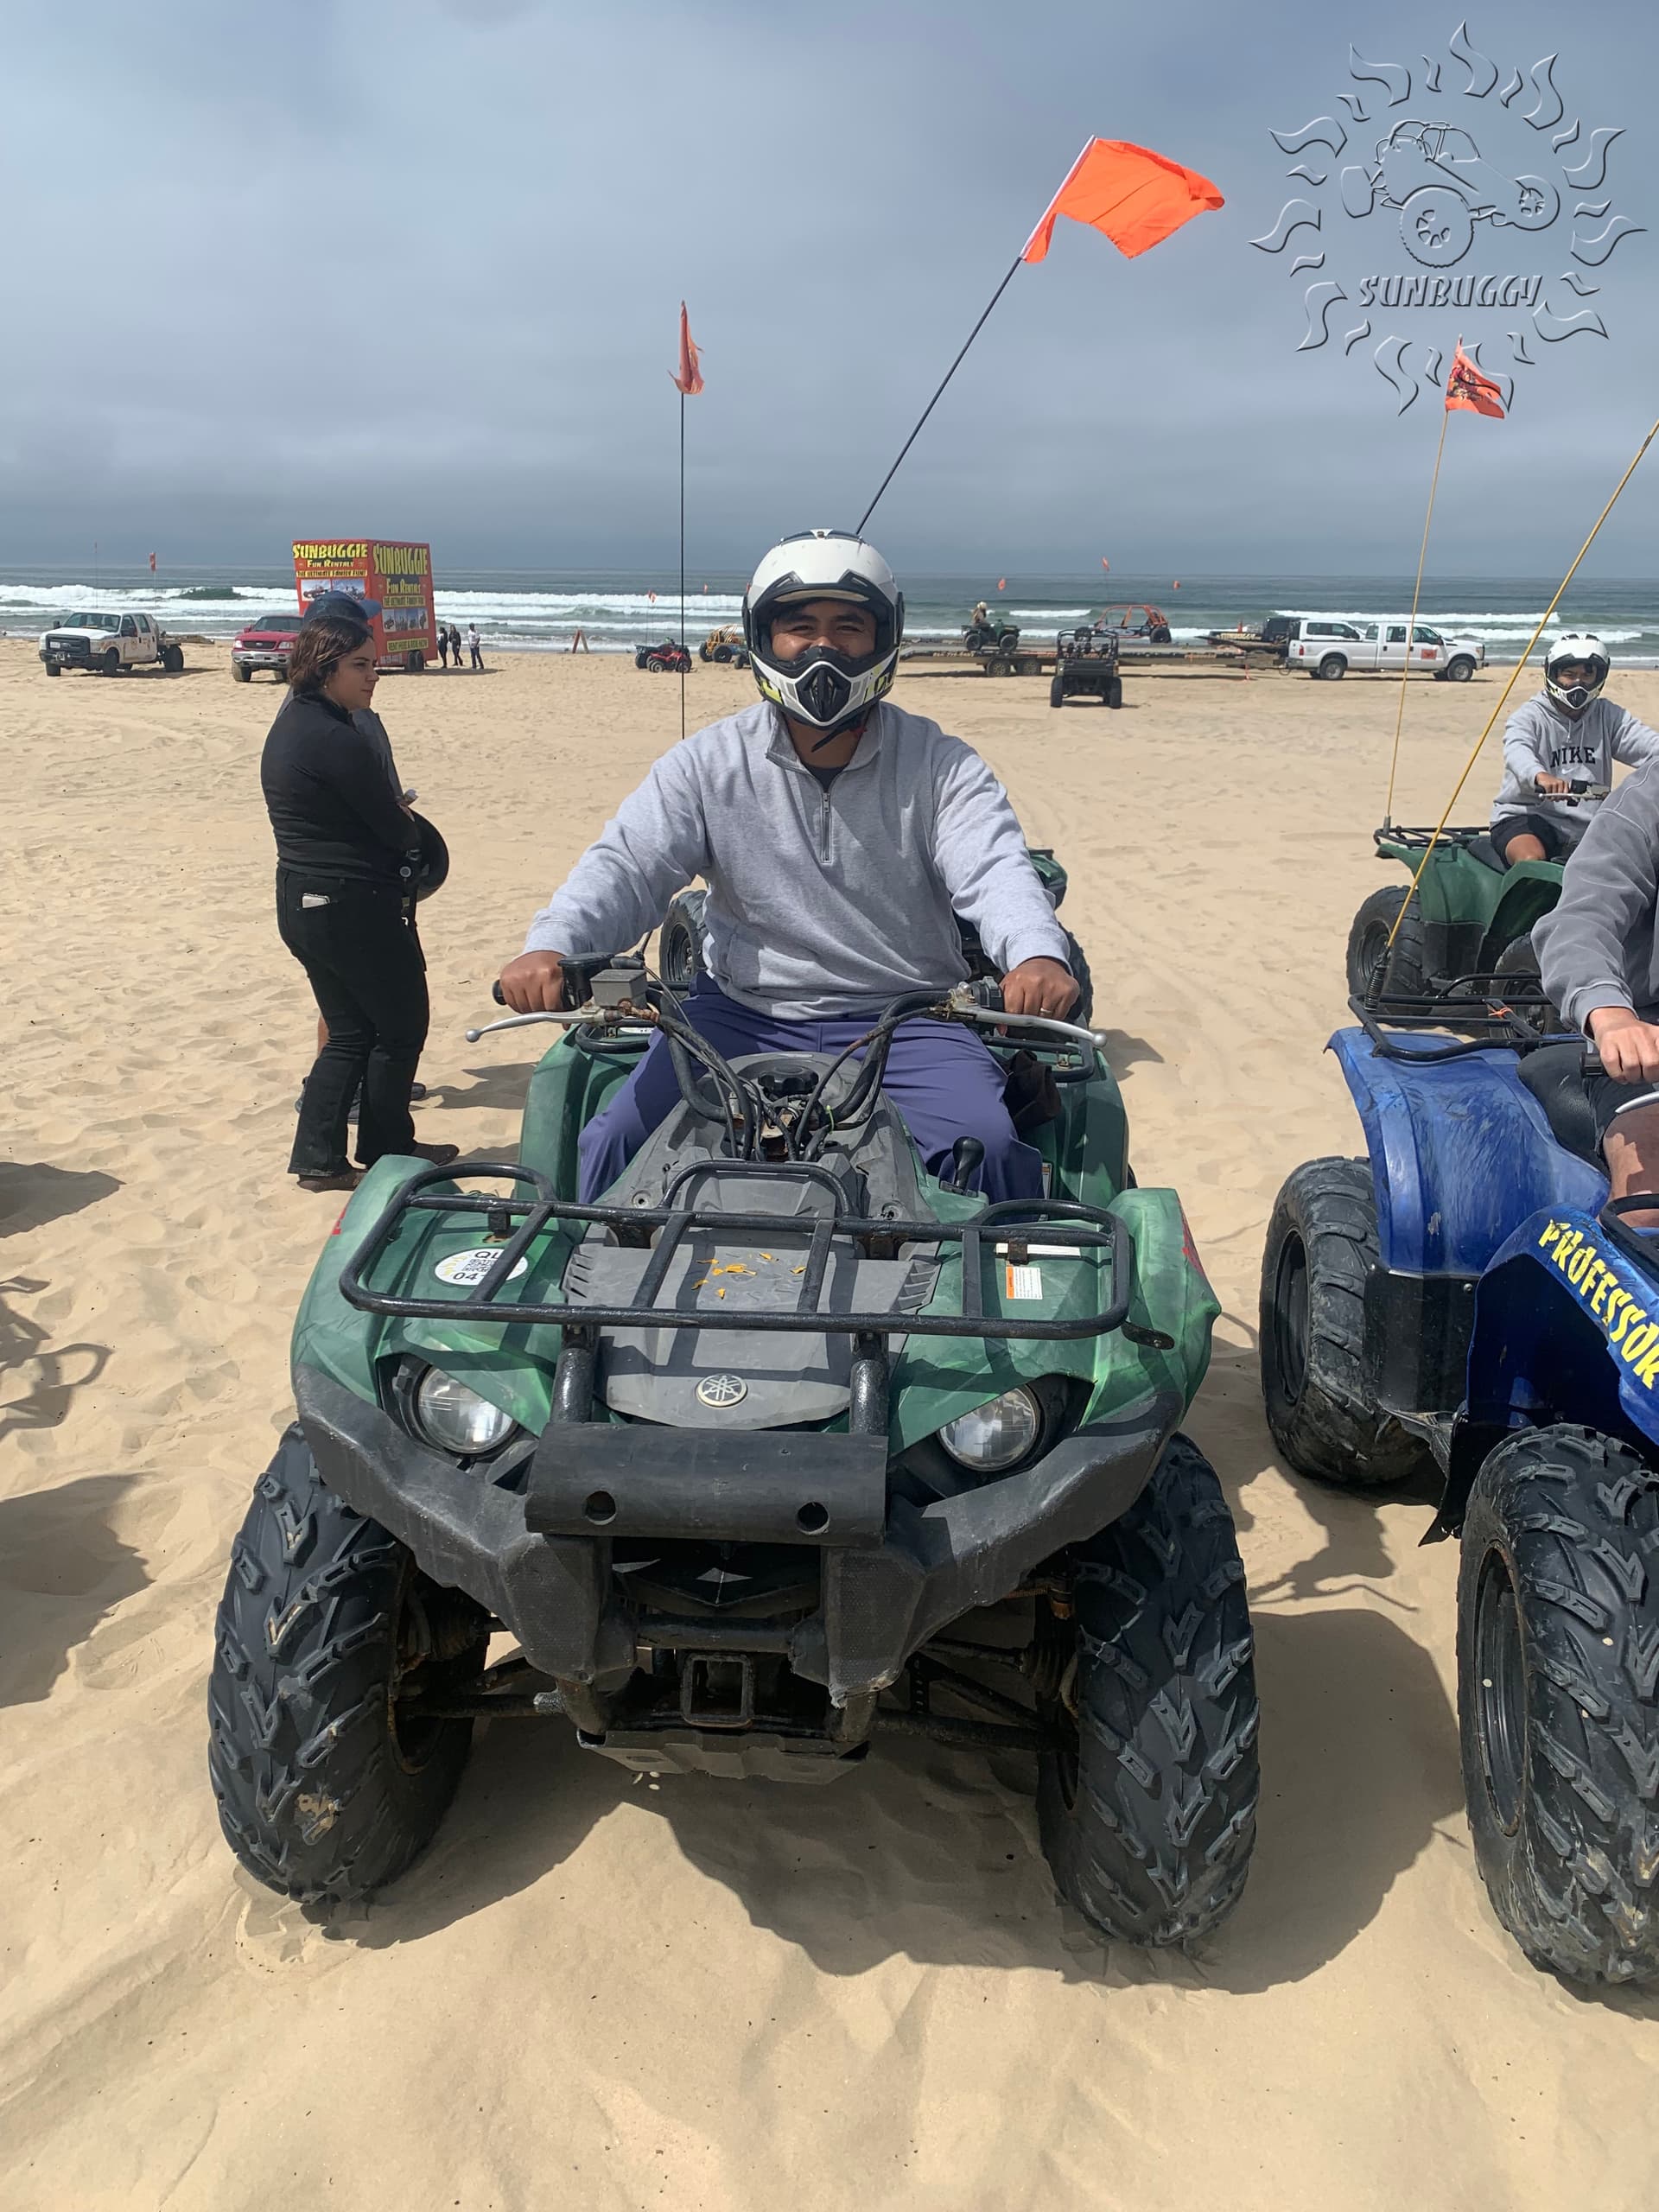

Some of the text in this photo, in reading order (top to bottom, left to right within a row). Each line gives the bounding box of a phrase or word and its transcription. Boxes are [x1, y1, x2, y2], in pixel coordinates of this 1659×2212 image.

[292, 543, 368, 559] SUNBUGGIE
[372, 543, 429, 575] SUNBUGGIE
[1550, 747, 1596, 768] NIKE
[1538, 1218, 1659, 1390] PROFESSOR
